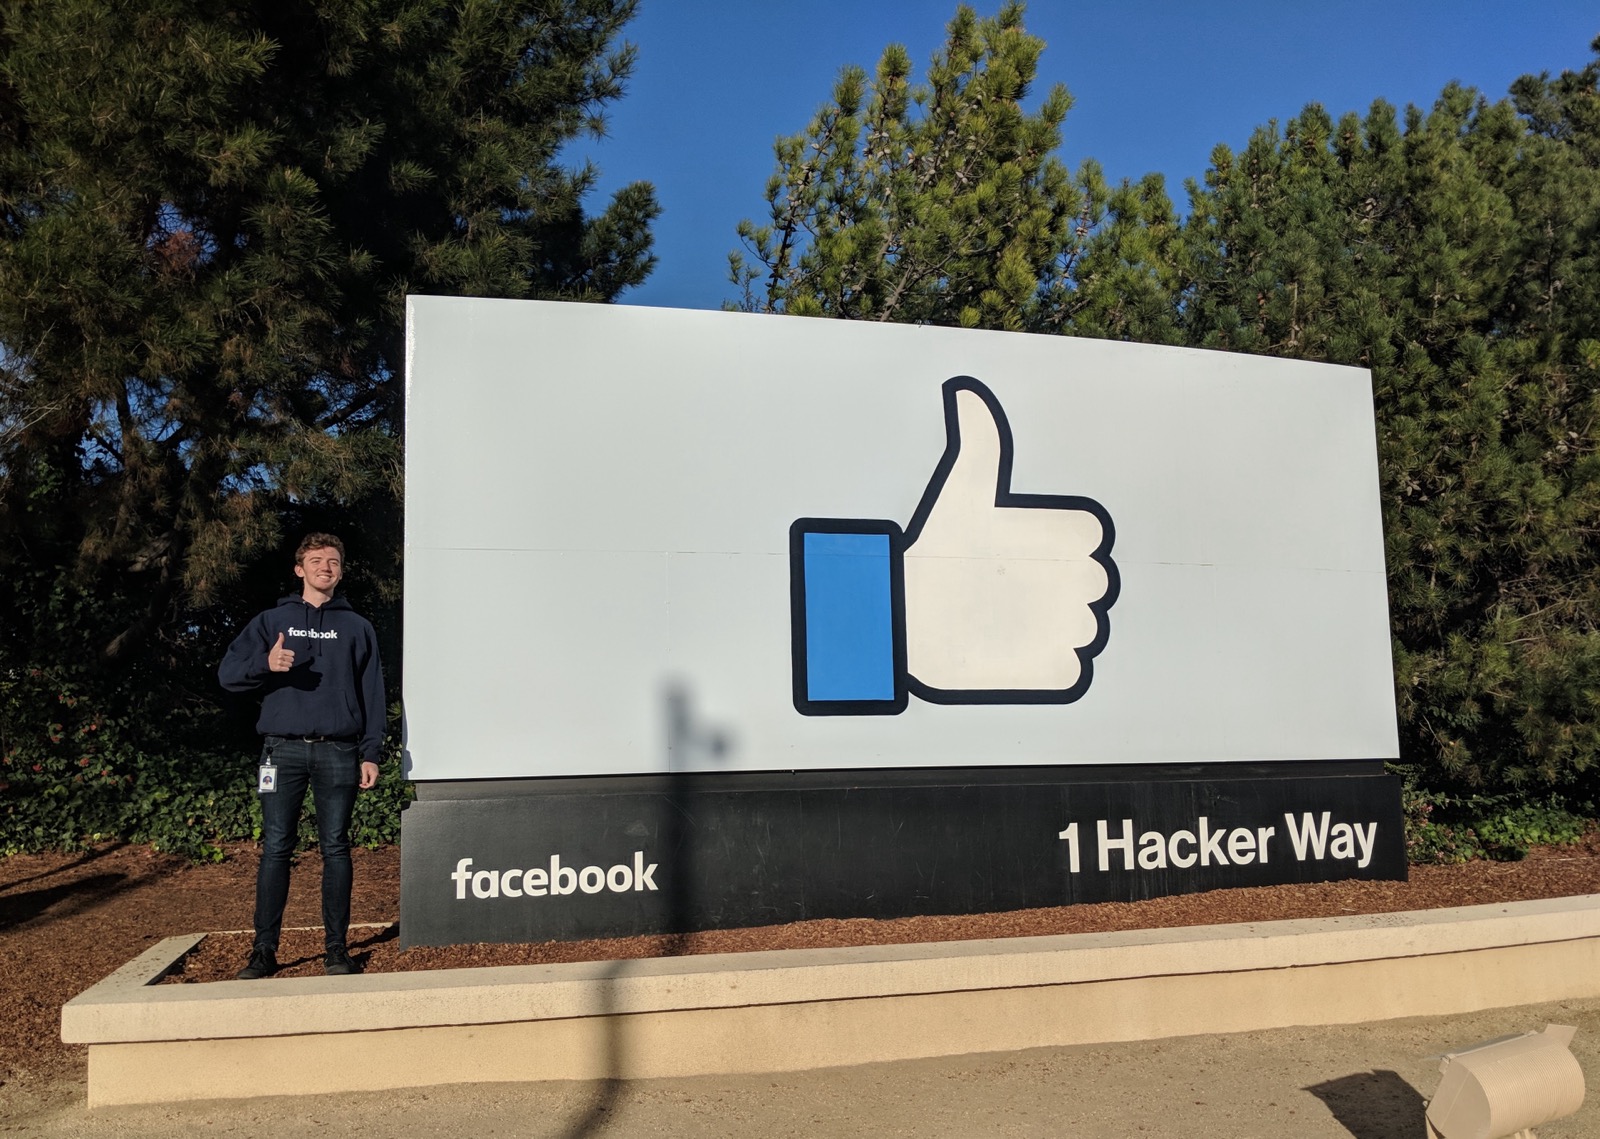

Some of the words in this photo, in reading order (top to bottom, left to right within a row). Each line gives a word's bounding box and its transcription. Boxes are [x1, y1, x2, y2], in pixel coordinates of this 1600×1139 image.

[1058, 822, 1080, 873] 1
[1096, 816, 1275, 871] Hacker
[1284, 811, 1378, 868] Way
[451, 851, 659, 900] facebook
